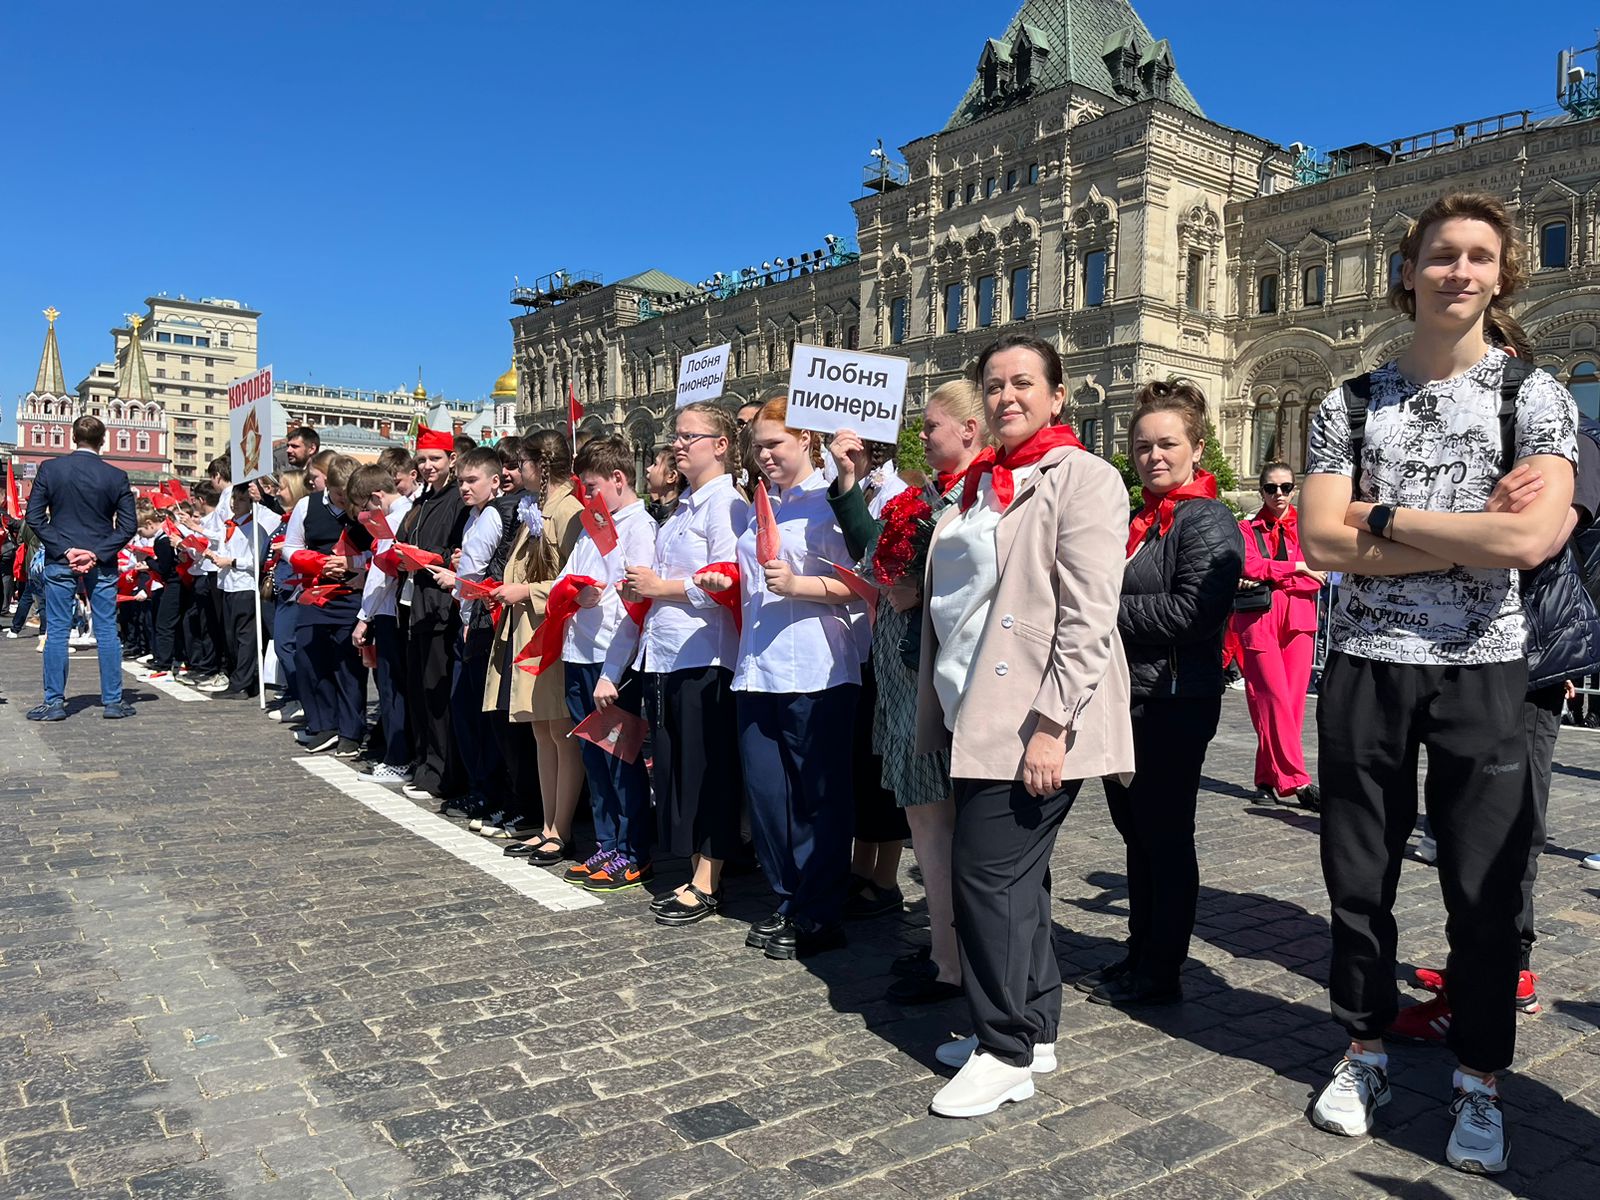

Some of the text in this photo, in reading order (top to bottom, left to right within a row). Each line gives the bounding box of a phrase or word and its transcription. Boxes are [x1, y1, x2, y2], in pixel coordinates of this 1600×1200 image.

[686, 353, 721, 374] Лобня
[807, 357, 889, 389] Лобня
[228, 368, 271, 410] КОРОЛЁВ
[678, 371, 723, 394] пионеры
[791, 389, 897, 421] пионеры
